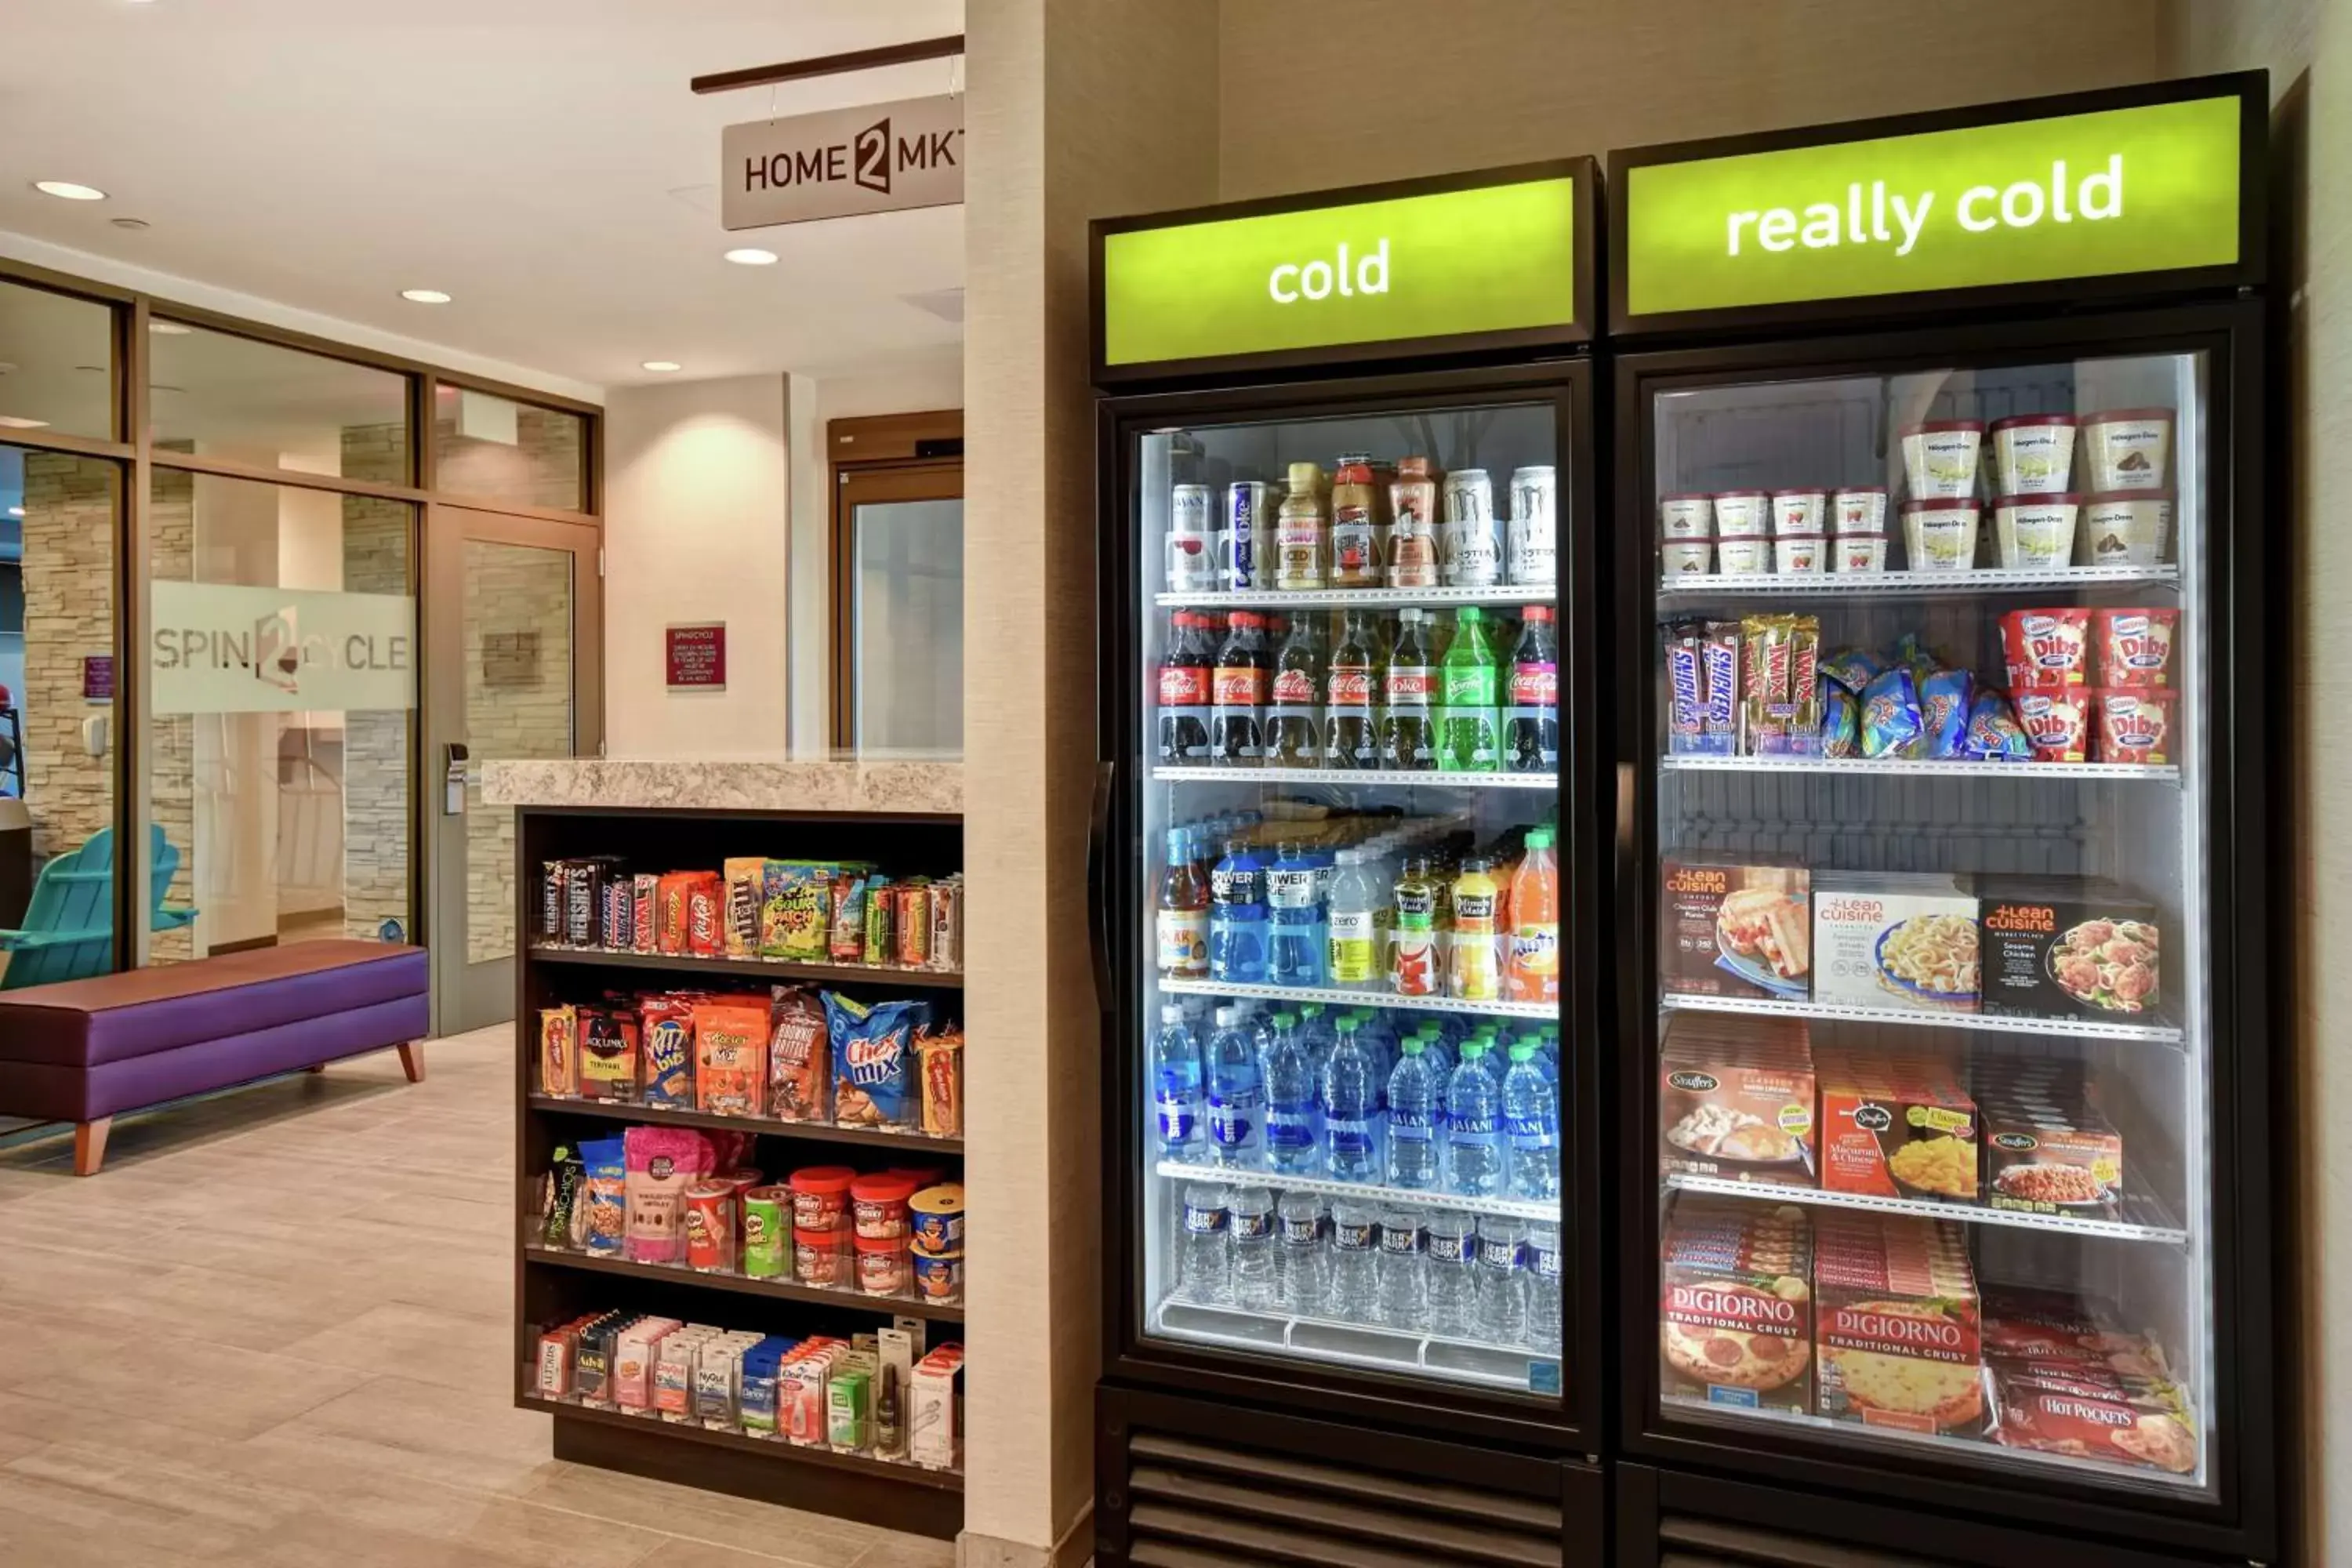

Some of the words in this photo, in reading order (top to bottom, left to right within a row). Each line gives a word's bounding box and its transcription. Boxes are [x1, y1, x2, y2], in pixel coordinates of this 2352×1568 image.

[745, 145, 848, 192] HOME
[858, 128, 888, 189] 2
[898, 129, 964, 172] MK
[1727, 180, 1935, 257] really
[1956, 153, 2123, 234] cold
[1269, 238, 1391, 304] cold
[154, 630, 249, 669] SPIN
[2032, 635, 2078, 657] Dibs
[2118, 633, 2168, 657] Dibs
[1769, 643, 1788, 697] TWIX
[1794, 648, 1814, 701] TWIX
[1386, 677, 1421, 693] Coke
[1674, 650, 1701, 725] SNICKERS
[1710, 648, 1733, 724] SNICKERS
[2028, 715, 2078, 736] Dibs
[2111, 715, 2163, 737] Dibs
[1686, 869, 1726, 883] Lean
[570, 867, 589, 941] HERSHEY'S
[1842, 900, 1883, 911] Lean
[2009, 906, 2054, 920] Lean
[651, 1027, 688, 1058] RITZ
[846, 1029, 899, 1064] Chex
[854, 1056, 902, 1084] mix
[1672, 1073, 1715, 1089] Stouffer's
[1829, 1144, 1879, 1157] Macaroni
[1673, 1287, 1795, 1321] DIGIORNO
[1668, 1312, 1752, 1332] TRADITIONAL
[1757, 1323, 1798, 1337] CRUST
[1836, 1310, 1961, 1346] DIGIORNO
[579, 1356, 605, 1370] Advil
[1828, 1335, 1918, 1356] TRADITIONAL
[1923, 1346, 1968, 1363] CRUST
[2046, 1399, 2071, 1415] HOT
[2074, 1403, 2133, 1426] POCKETS
